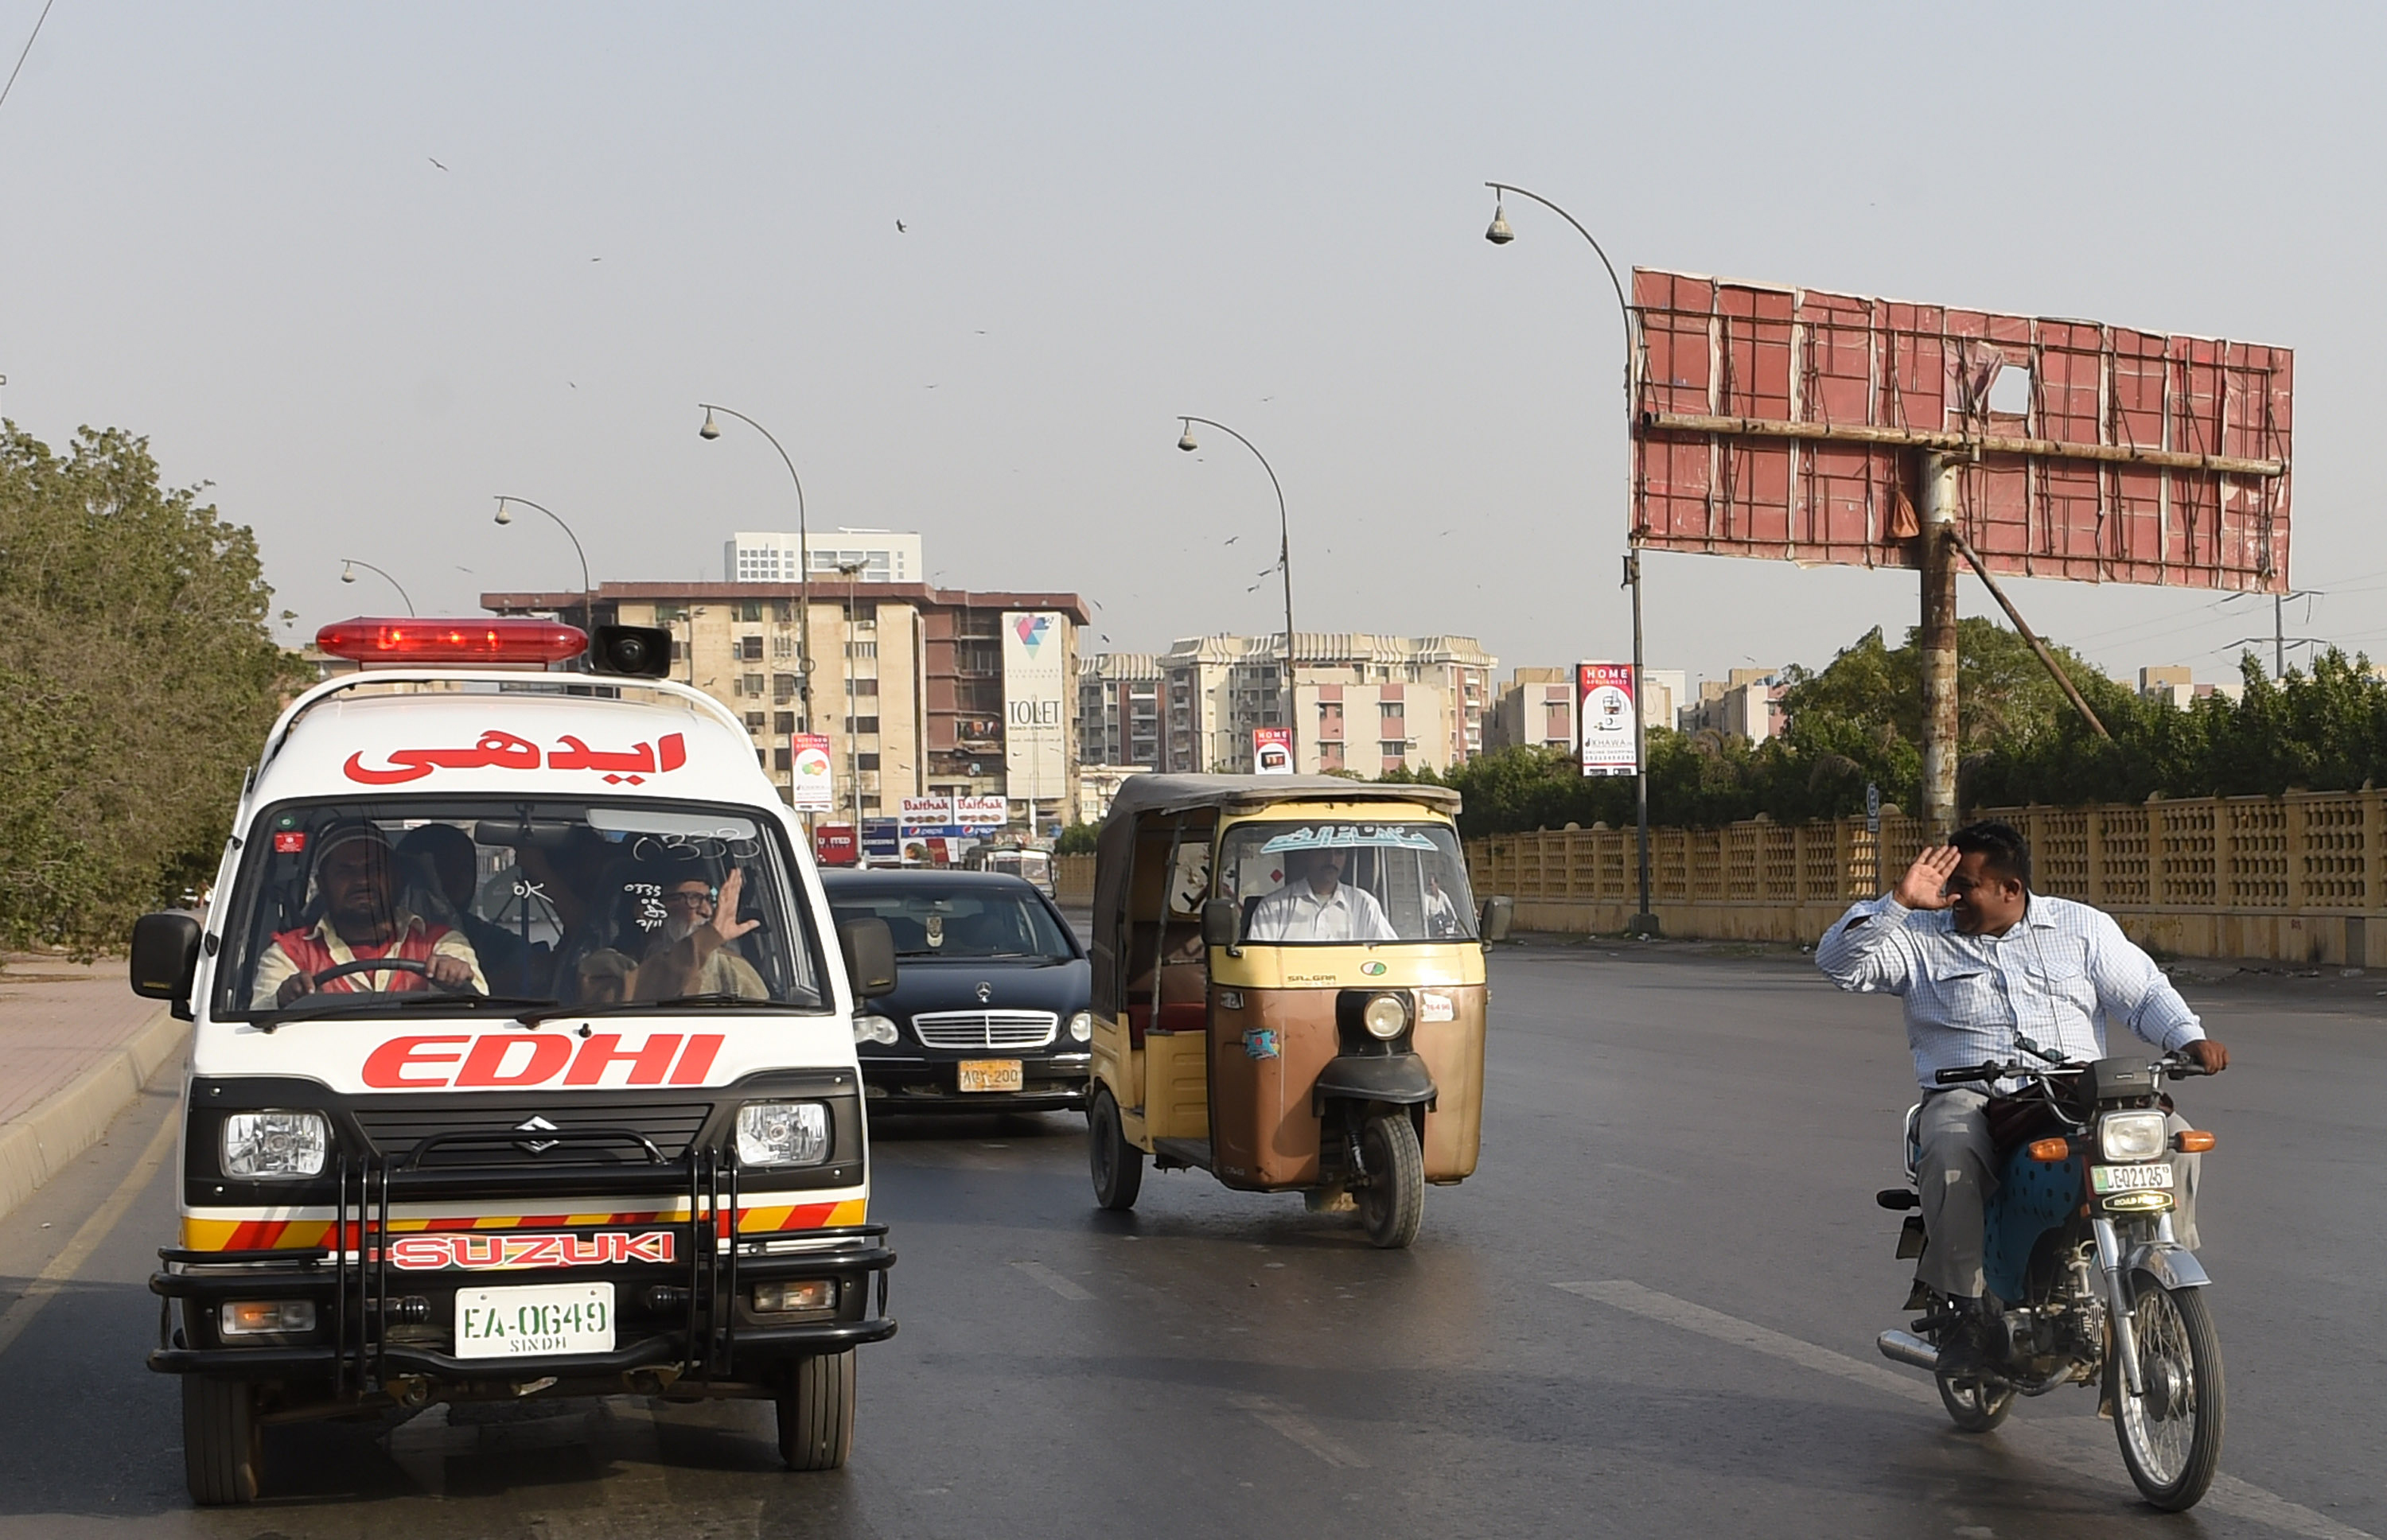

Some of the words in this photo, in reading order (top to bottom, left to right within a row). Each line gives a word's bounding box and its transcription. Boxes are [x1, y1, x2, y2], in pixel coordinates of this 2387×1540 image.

[1587, 669, 1628, 679] HOME
[903, 799, 949, 811] Baithak
[958, 798, 1003, 810] Baithak
[362, 1034, 725, 1087] EDHI
[393, 1232, 675, 1270] SUZUKI
[510, 1336, 567, 1352] SINDH
